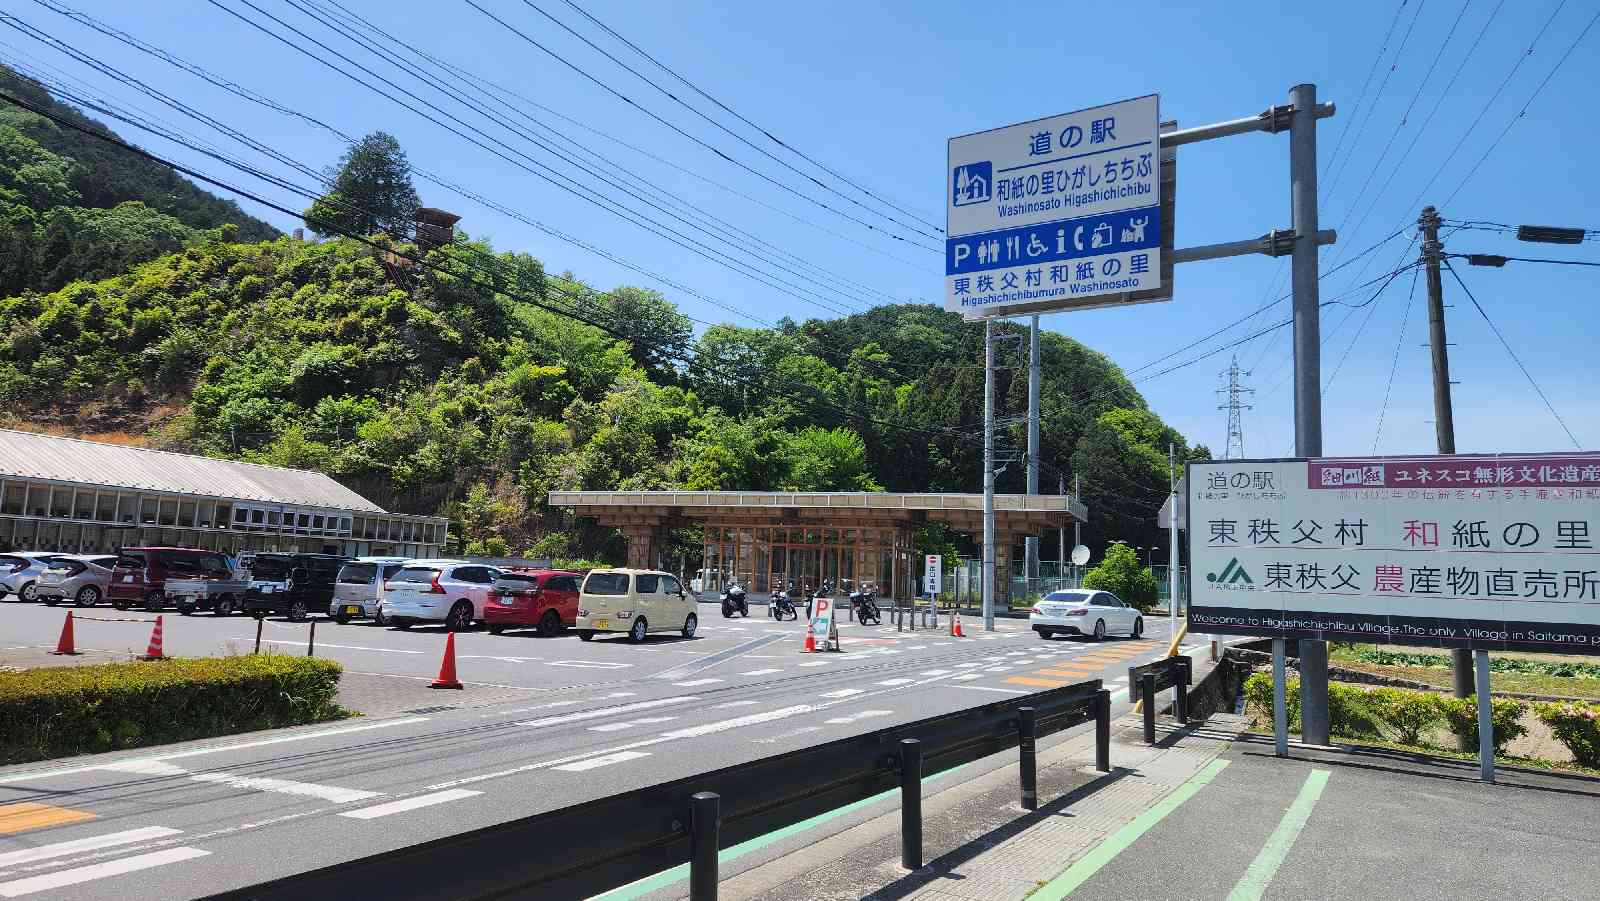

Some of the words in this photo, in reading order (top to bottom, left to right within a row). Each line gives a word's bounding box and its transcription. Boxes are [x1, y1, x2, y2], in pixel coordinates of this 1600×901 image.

[1029, 117, 1116, 156] 道の駅
[997, 153, 1153, 202] 和紙の里ひがしちちぶ
[998, 199, 1060, 218] Washinosato
[1064, 182, 1151, 207] Higashichichibu
[954, 243, 970, 268] P
[953, 253, 1150, 296] 東秩父村和紙の里
[961, 287, 1066, 307] Higashichichibumura
[1070, 277, 1139, 294] Washinosato
[1207, 471, 1275, 490] 道の駅
[1395, 465, 1600, 483] ユネスコ無形文化遺産
[1208, 518, 1369, 545] 東秩父村
[1403, 519, 1593, 549] 和紙の里
[1263, 562, 1361, 590] 東秩父
[1374, 564, 1600, 599] 農産物直売所
[816, 599, 829, 618] P
[1191, 613, 1245, 624] Welcome
[1248, 616, 1259, 626] to
[1262, 618, 1355, 631] Higashichichibu
[1429, 626, 1456, 638] only
[1463, 628, 1509, 641] Village
[1512, 632, 1524, 640] in
[1527, 630, 1587, 643] Saitama
